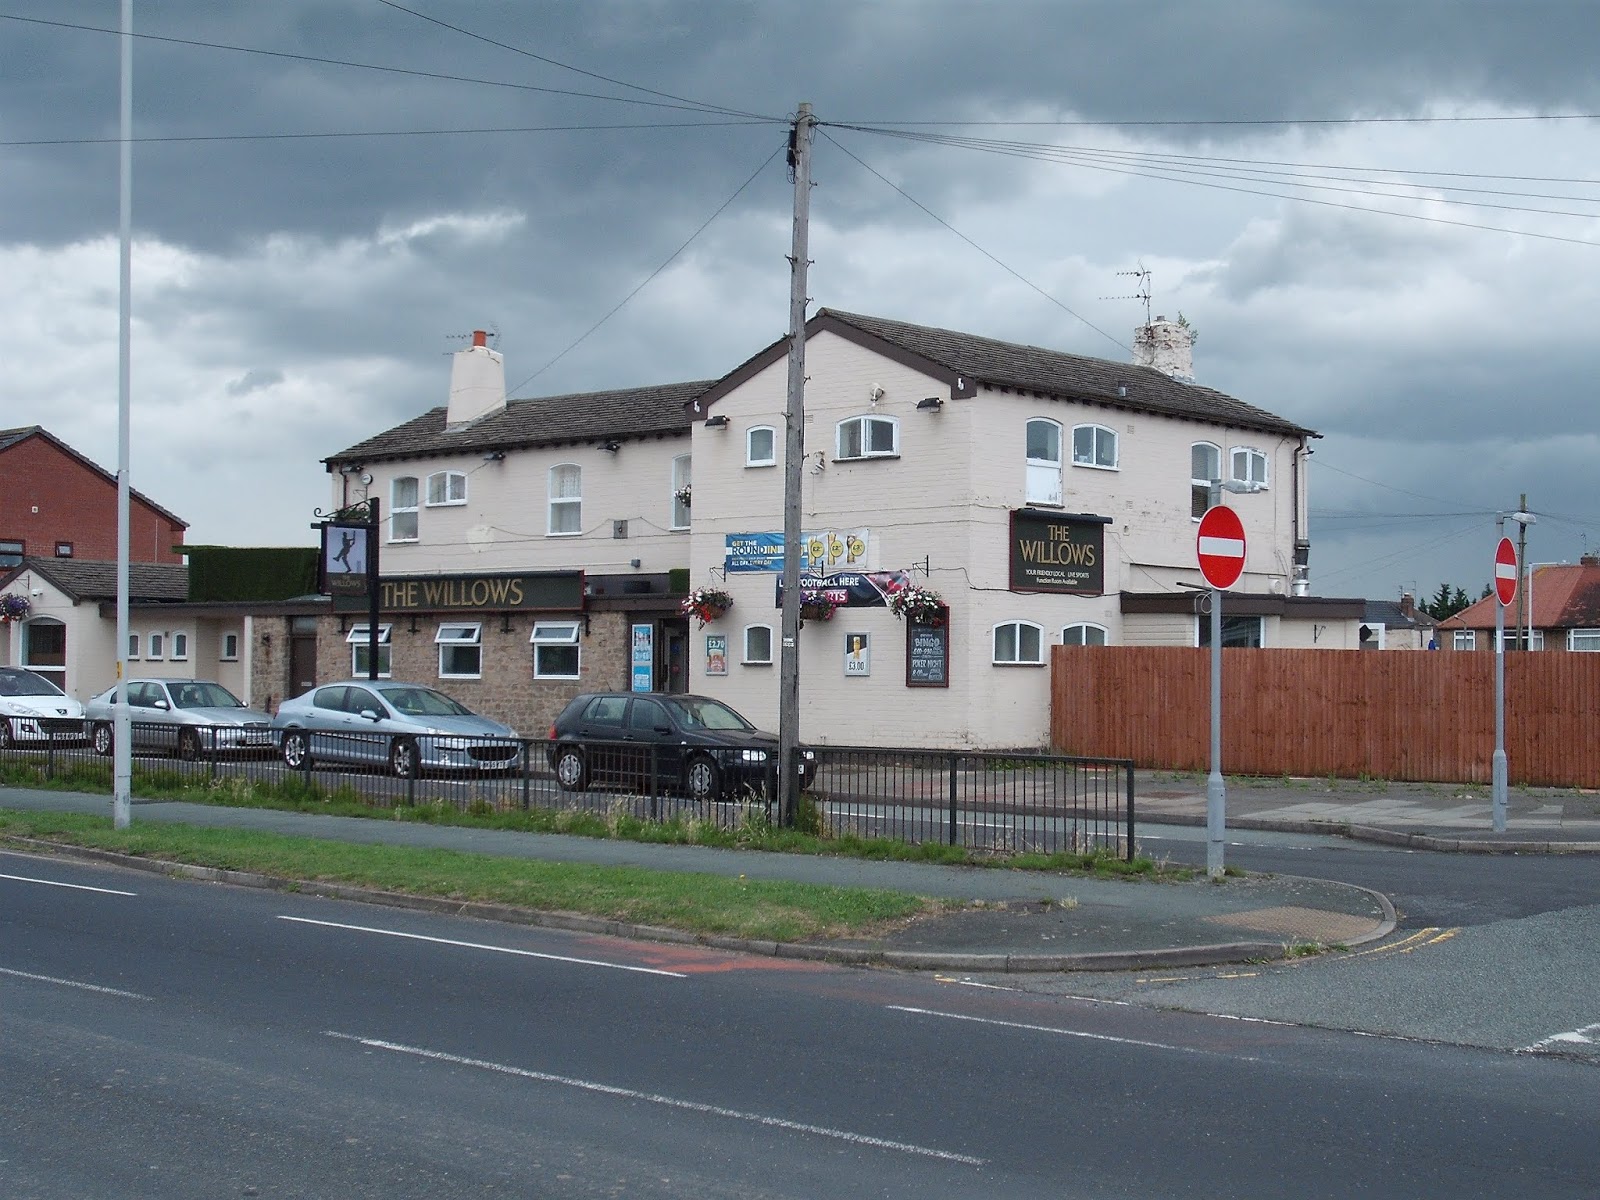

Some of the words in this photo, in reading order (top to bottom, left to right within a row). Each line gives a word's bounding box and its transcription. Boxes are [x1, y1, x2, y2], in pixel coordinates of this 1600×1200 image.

[1048, 525, 1070, 541] THE
[732, 546, 766, 555] ROUND
[767, 545, 779, 554] IN
[1020, 540, 1095, 567] WILLOWS
[839, 577, 860, 586] HERE
[381, 582, 418, 607] THE
[424, 578, 524, 606] WILLOWS
[708, 640, 725, 648] £2.70
[914, 638, 940, 647] BINGO
[848, 661, 865, 671] £3.00
[912, 660, 927, 668] POKER
